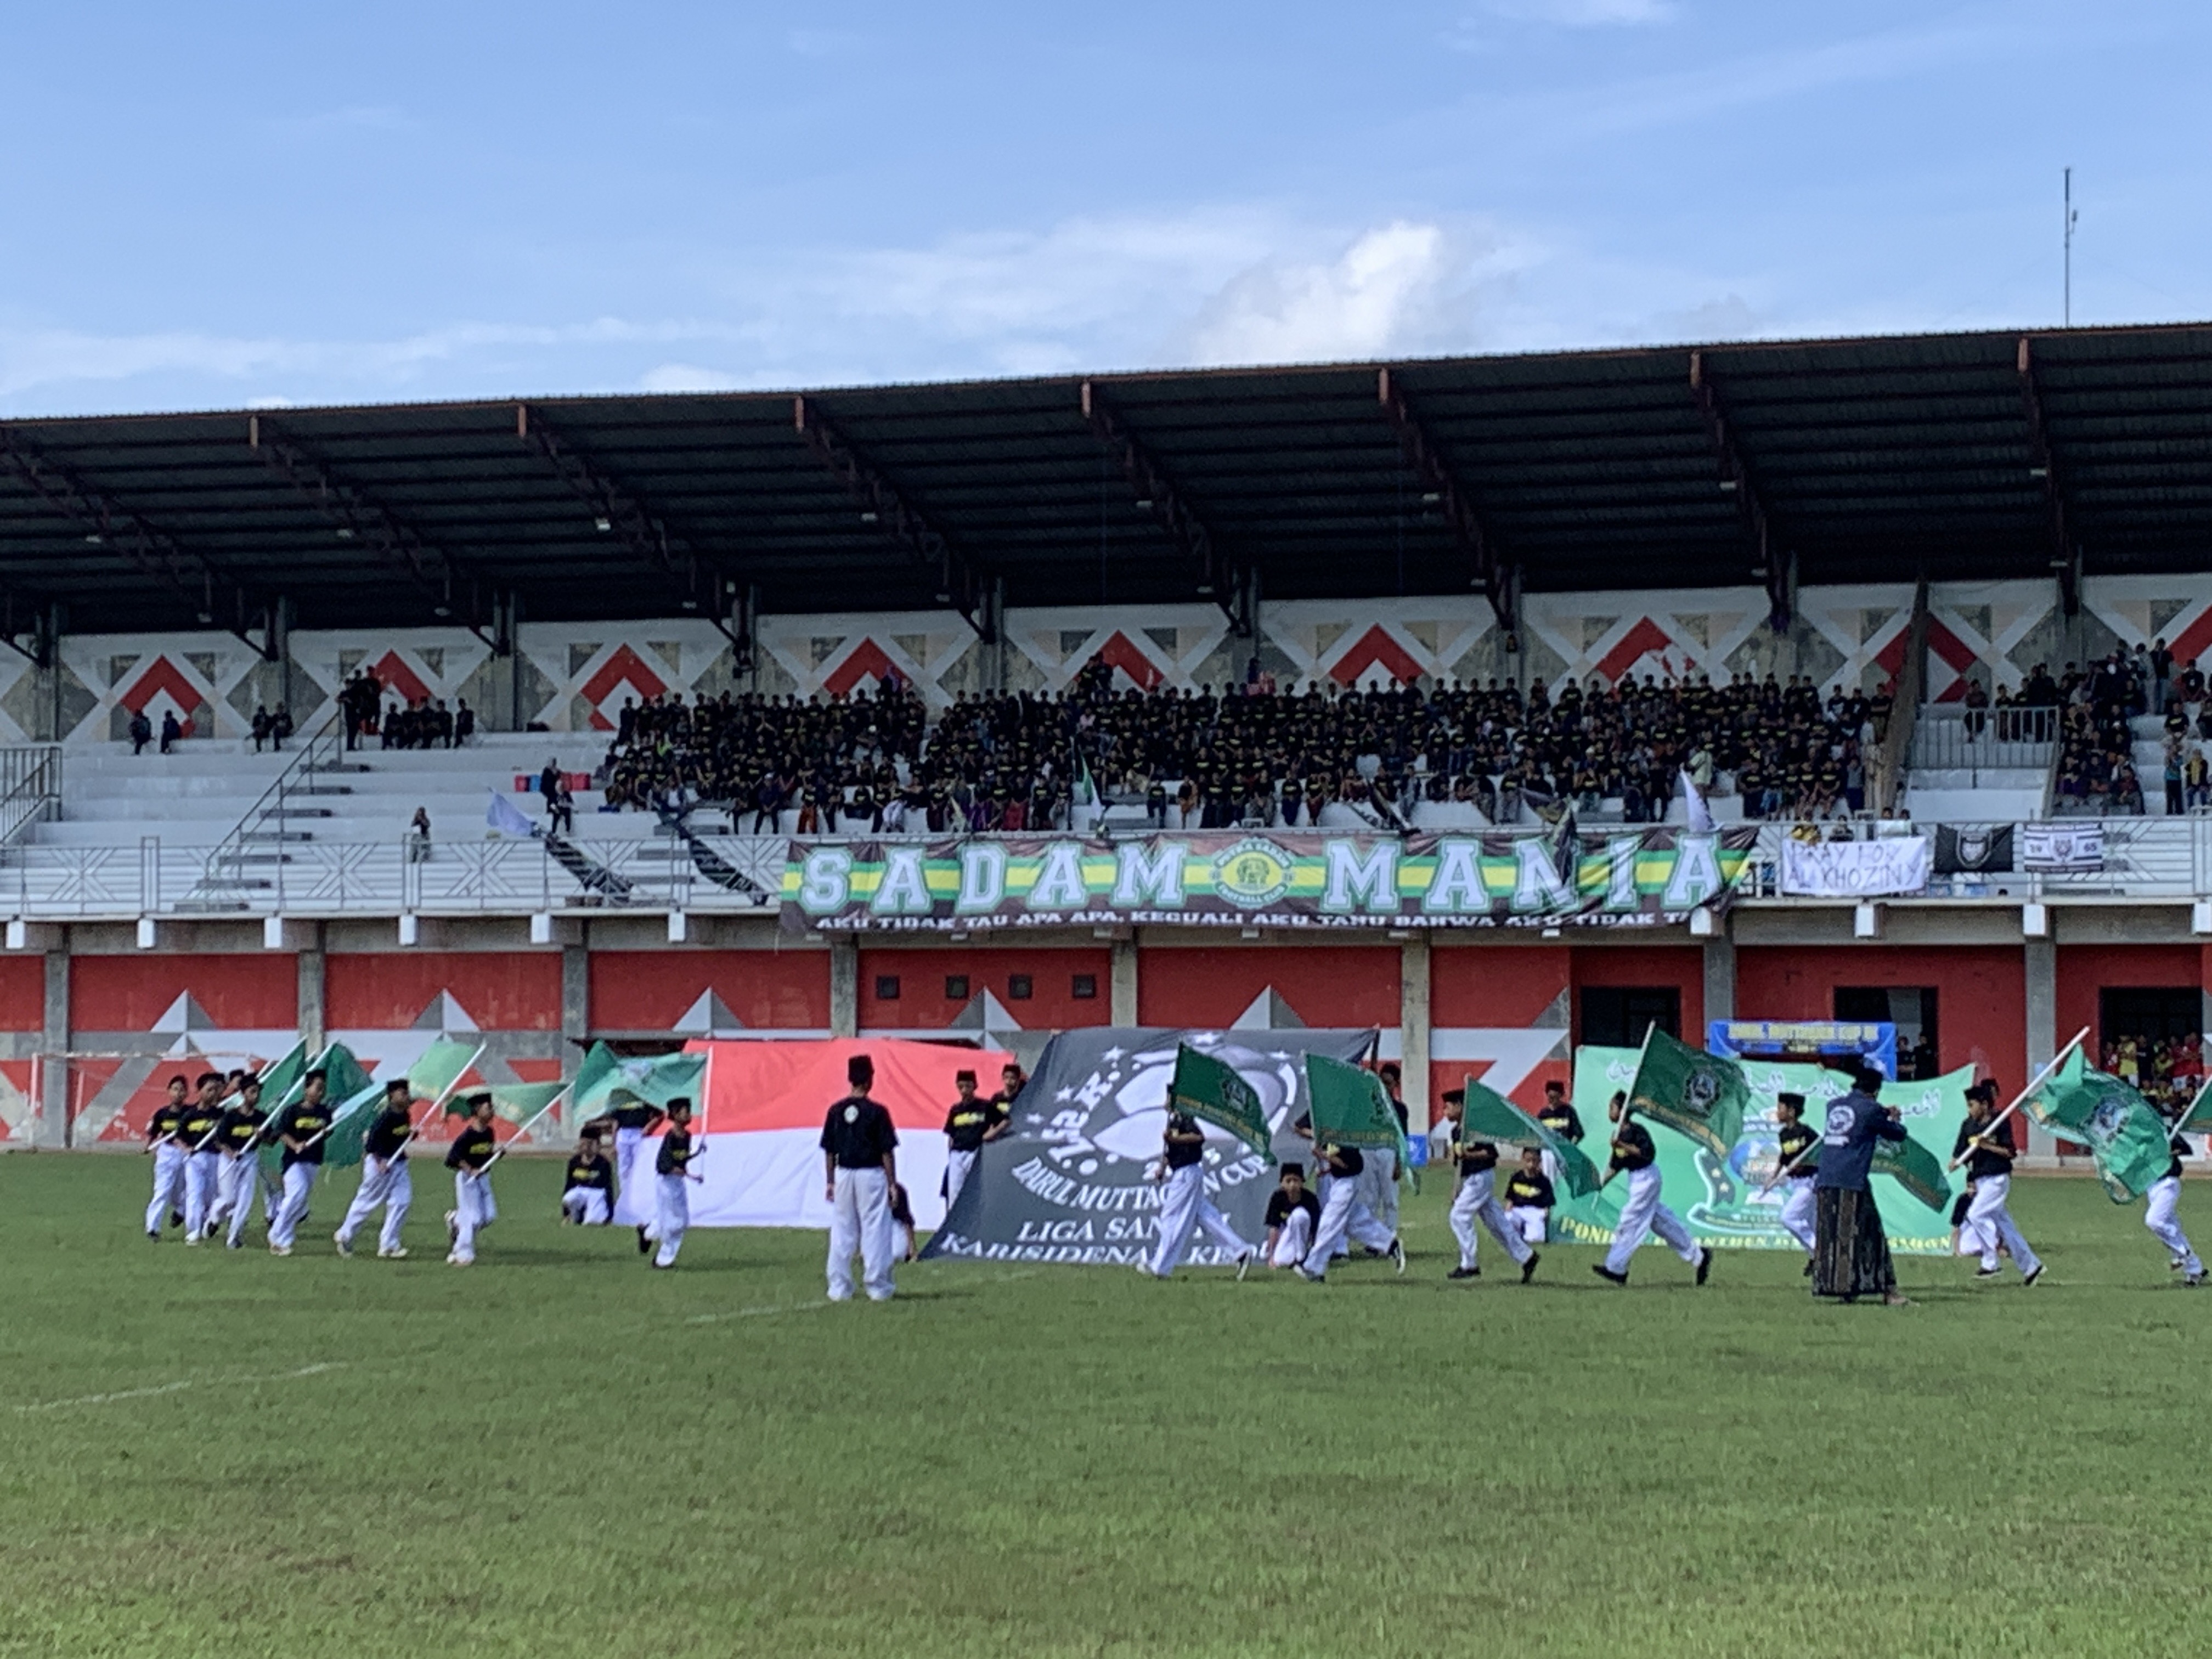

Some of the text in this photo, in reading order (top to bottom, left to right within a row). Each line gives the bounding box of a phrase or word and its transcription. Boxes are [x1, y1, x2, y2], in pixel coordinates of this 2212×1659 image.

[797, 833, 1727, 913] SADAM MANIA
[816, 917, 870, 929] AKU
[877, 916, 957, 929] TIDAK
[963, 915, 1009, 927] TAU
[1015, 912, 1062, 926] APA
[1251, 913, 1310, 926] AKU
[1317, 915, 1387, 927] TAHU
[1394, 915, 1496, 927] BAHWA
[1011, 1155, 1077, 1206] DARUL
[1220, 1154, 1268, 1186] CUP
[1016, 1218, 1095, 1242] LIGA
[939, 1232, 1160, 1265] KARISIDENA
